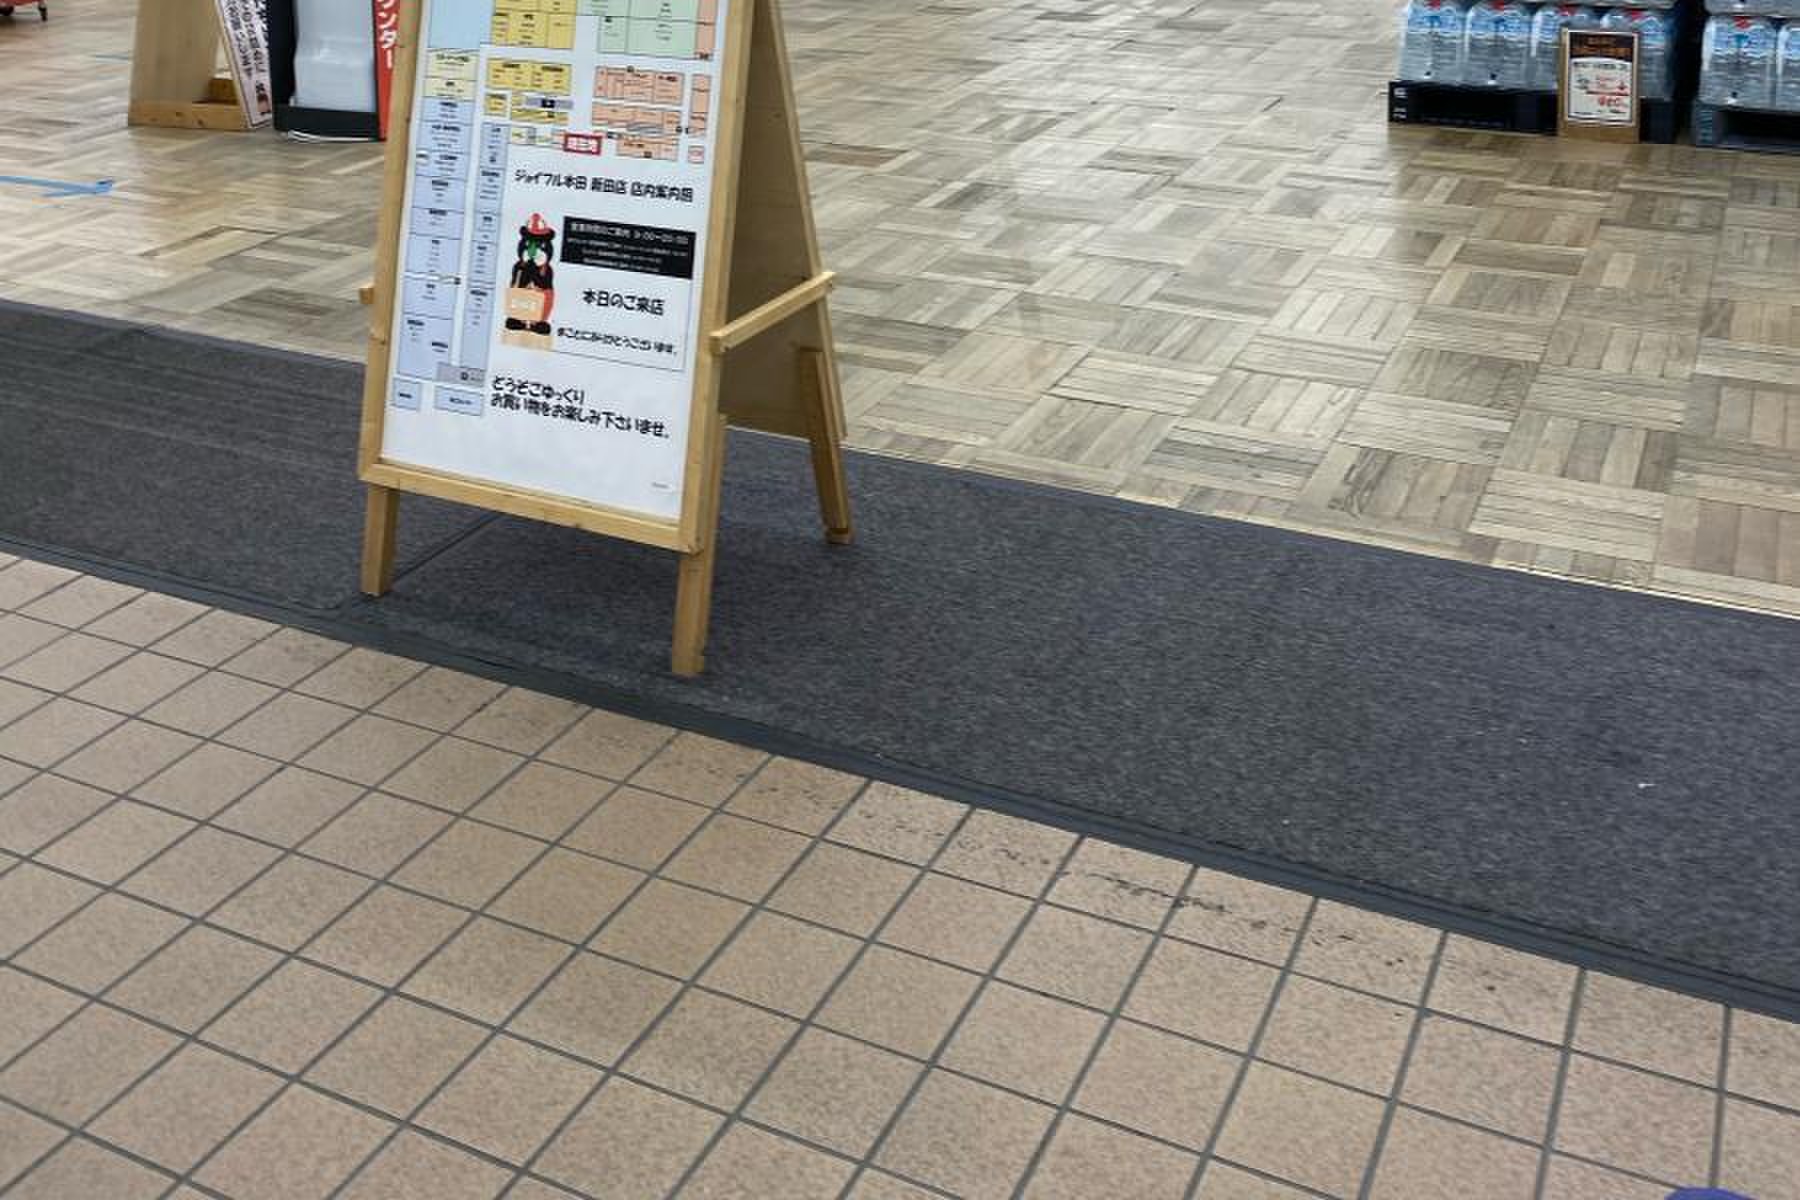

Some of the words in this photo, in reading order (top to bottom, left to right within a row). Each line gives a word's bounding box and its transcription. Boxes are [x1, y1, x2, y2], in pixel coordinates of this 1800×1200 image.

[514, 168, 588, 191] ジョイフル本田
[582, 287, 666, 316] 本日のご来店
[491, 374, 585, 404] どうぞごゆっくり
